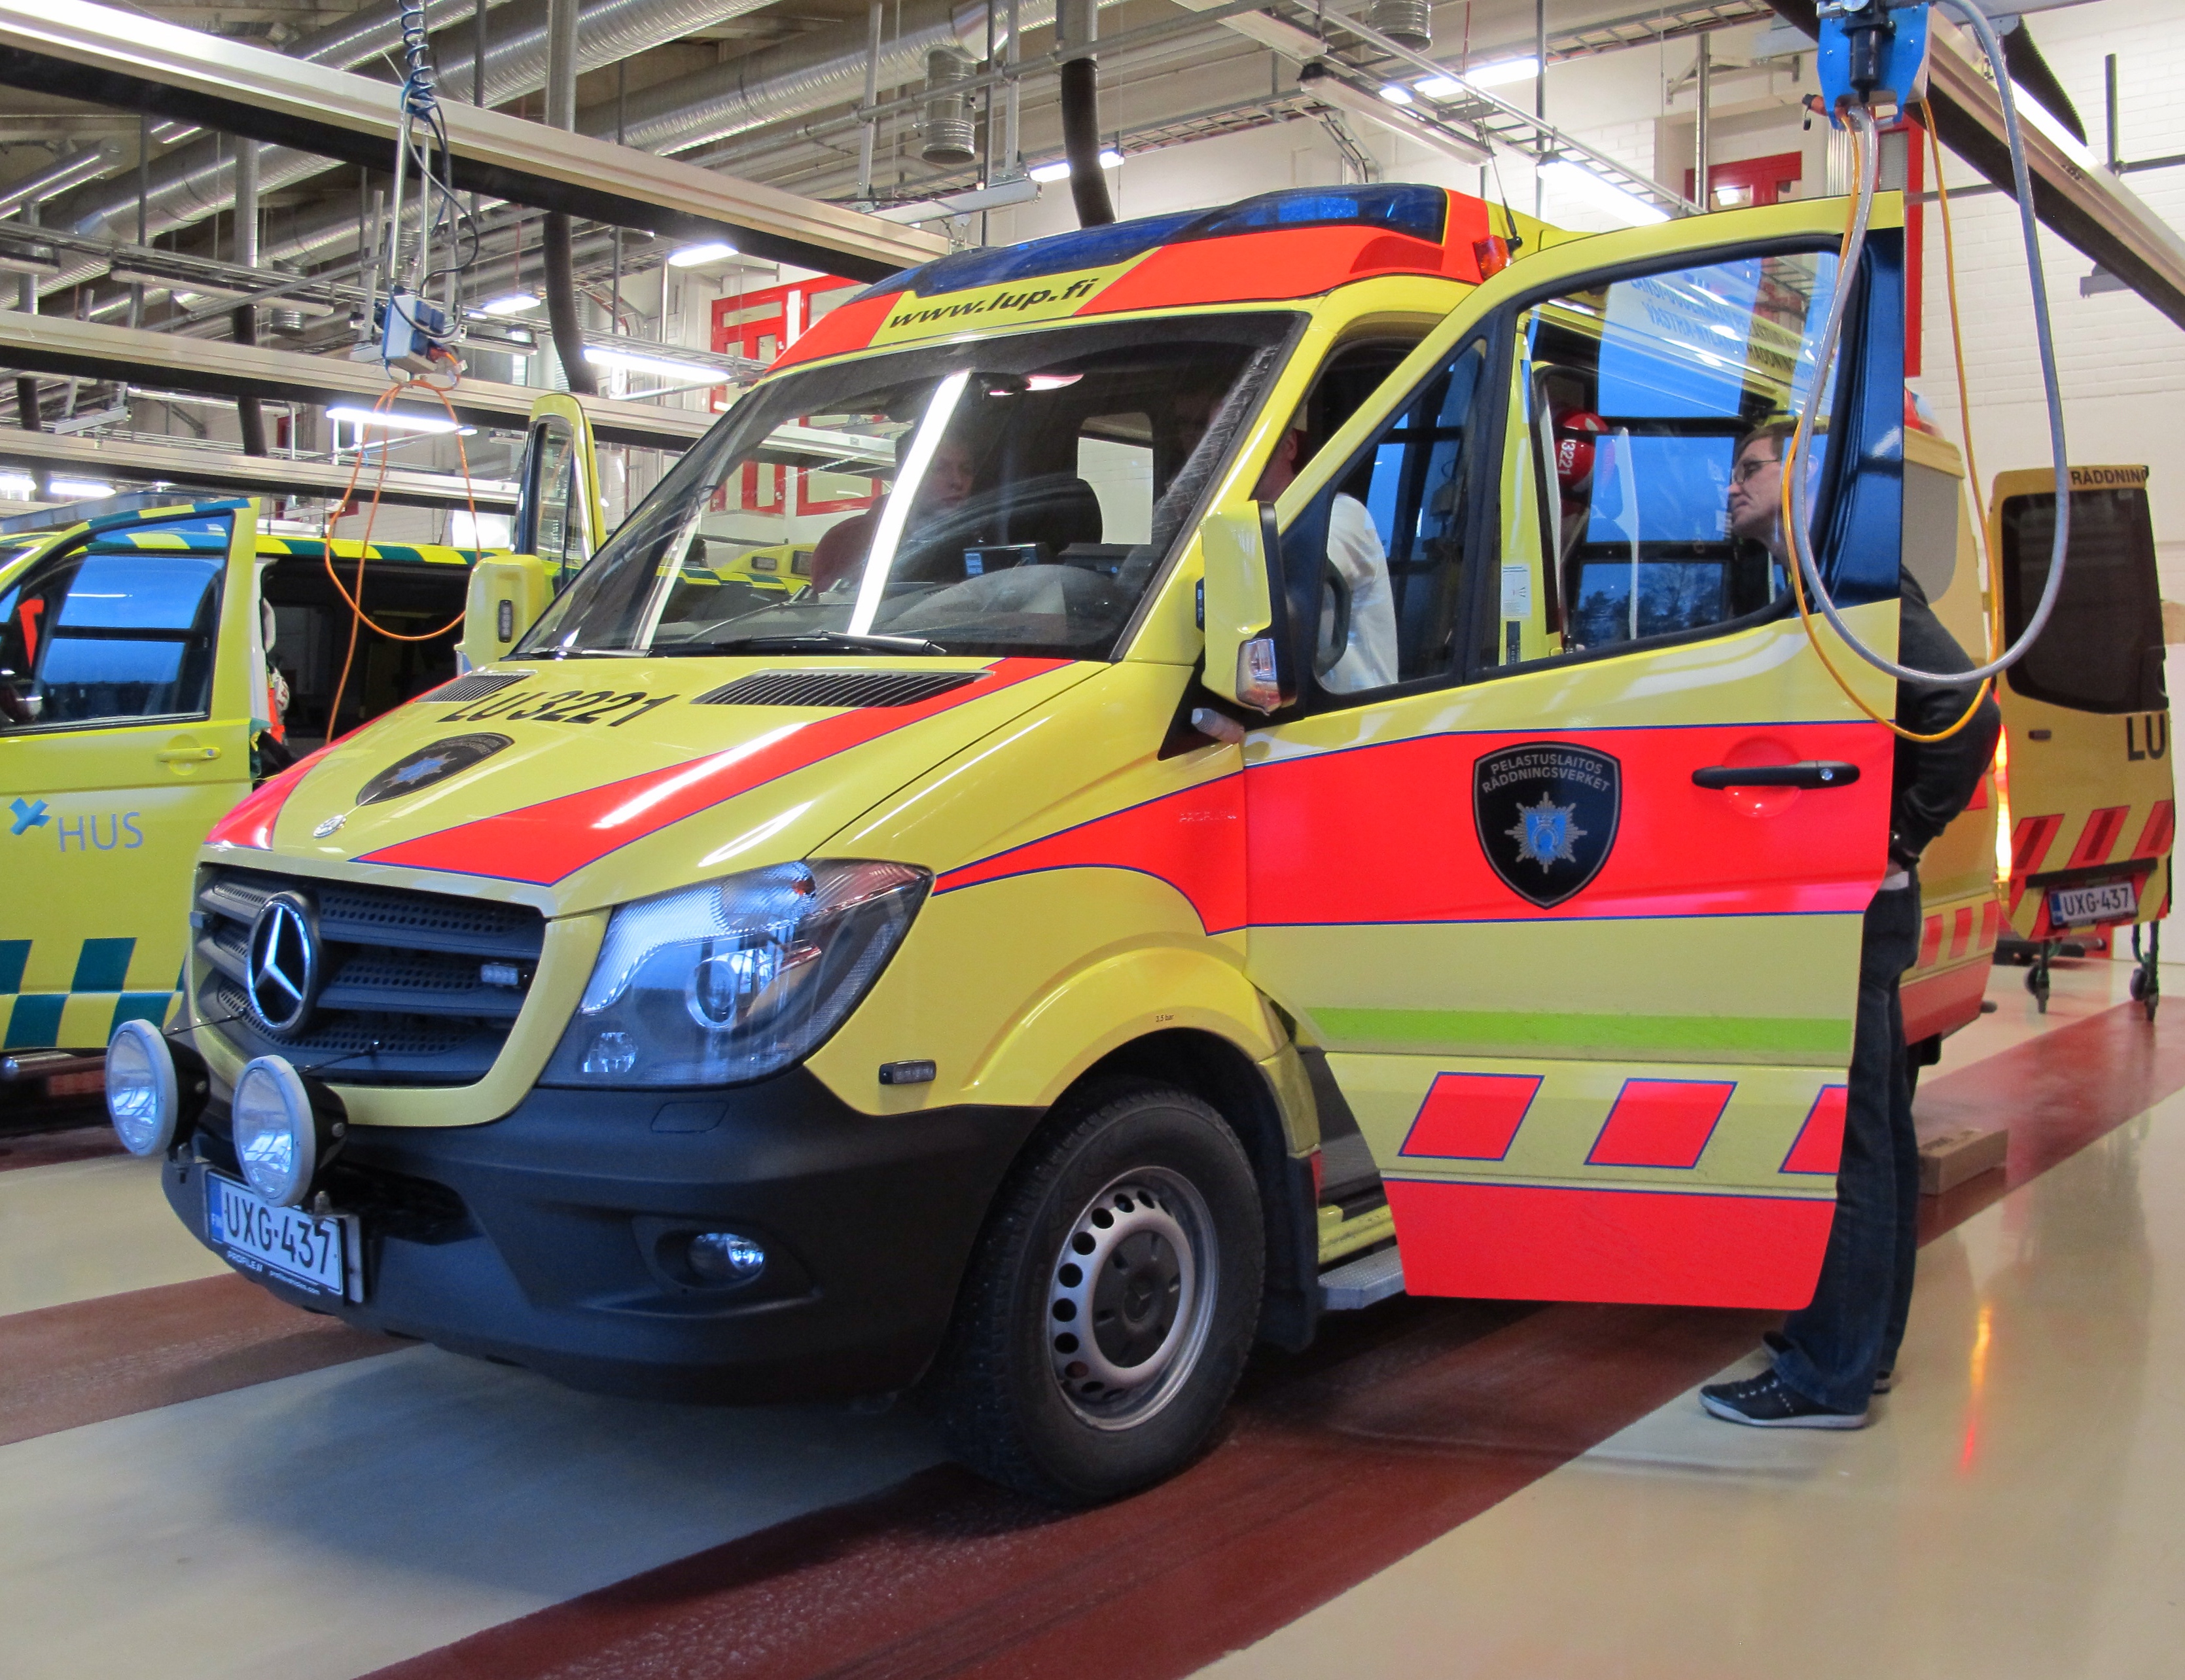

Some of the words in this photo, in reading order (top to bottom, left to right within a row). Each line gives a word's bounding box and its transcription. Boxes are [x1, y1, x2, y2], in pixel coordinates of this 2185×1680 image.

[889, 277, 1100, 328] www.lup.fi
[2126, 713, 2165, 761] LU
[1481, 766, 1611, 793] RÄDDNINGSVERKET
[1490, 753, 1603, 775] PELASTUSLAITOS
[58, 811, 144, 852] HUS
[2063, 887, 2129, 916] UXG-437
[226, 1192, 331, 1275] UXG-437
